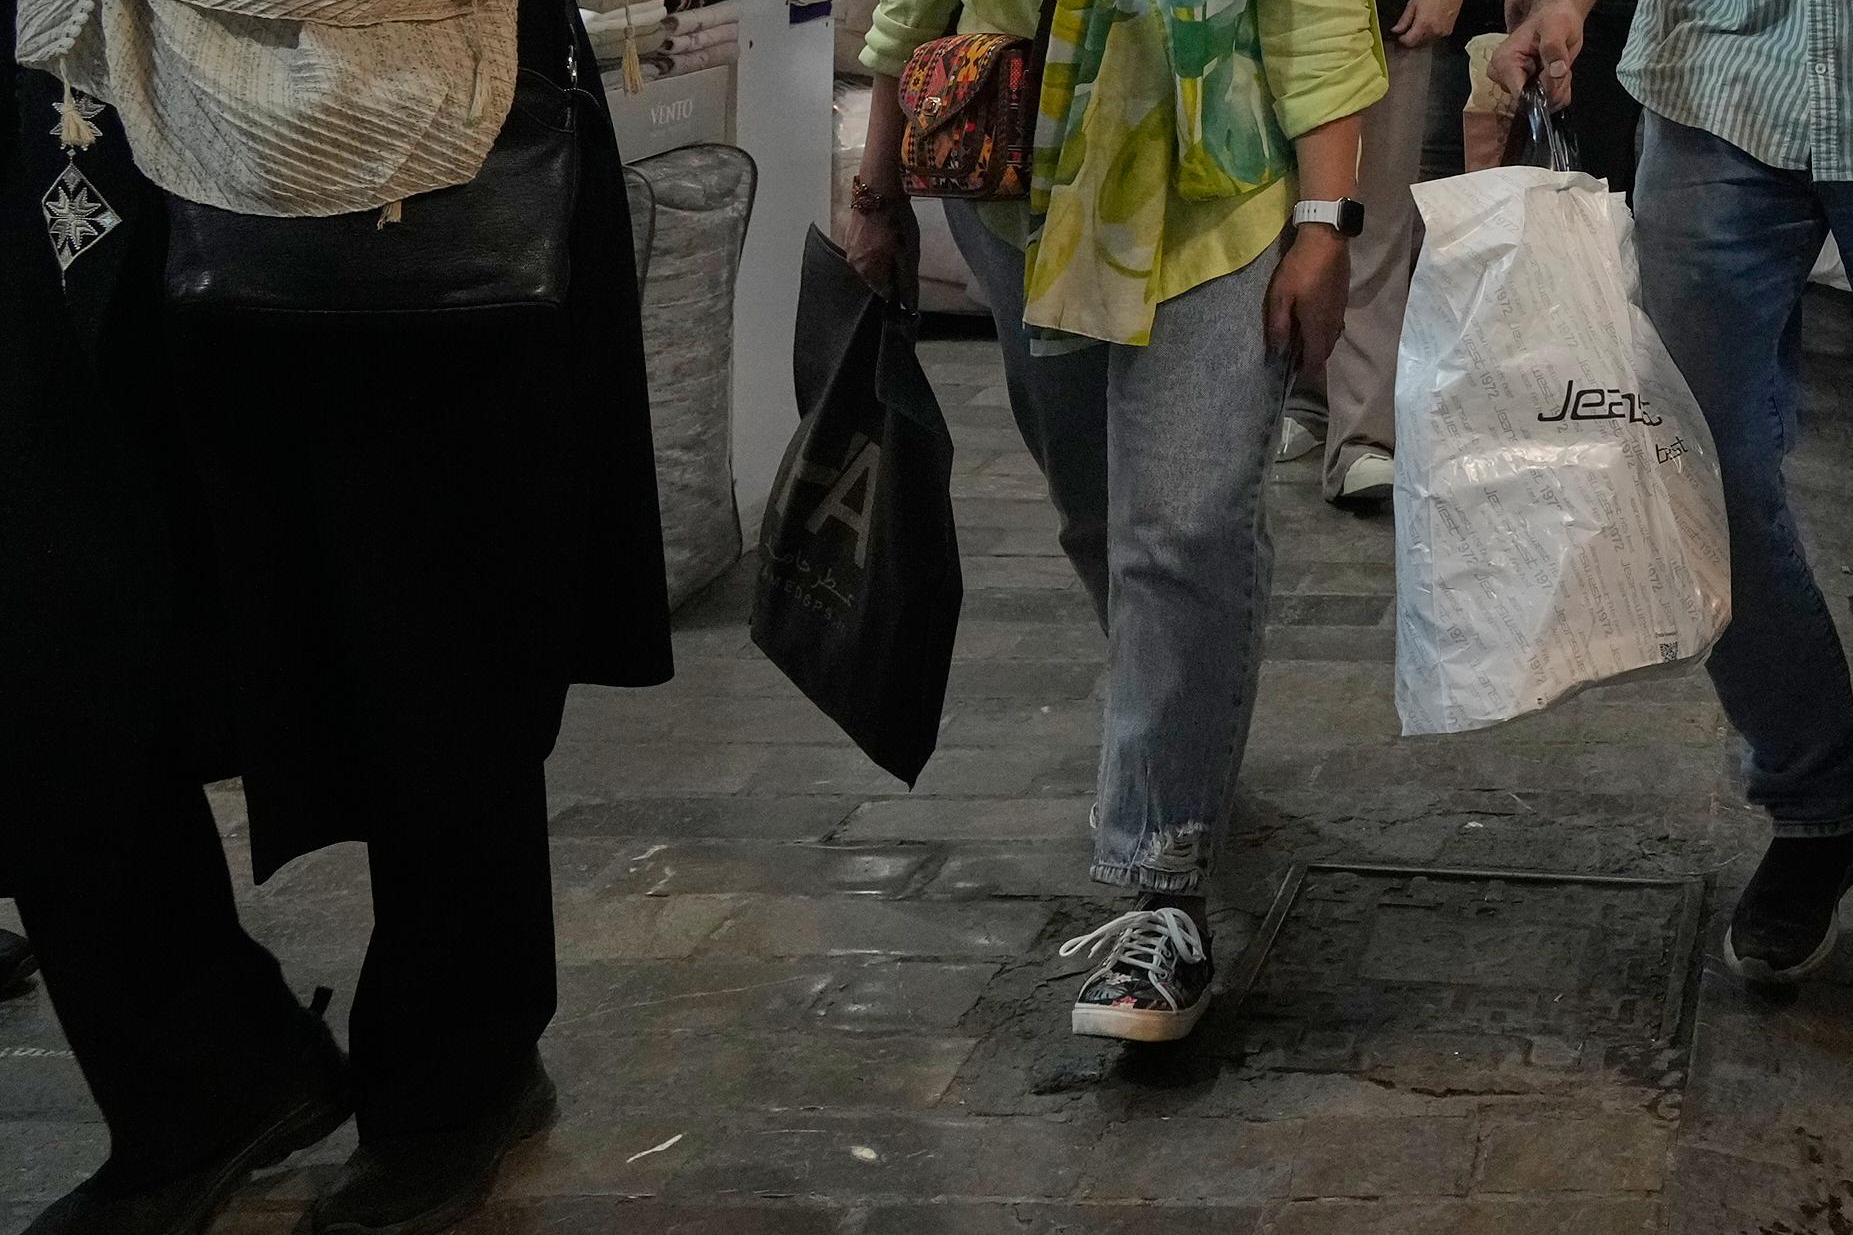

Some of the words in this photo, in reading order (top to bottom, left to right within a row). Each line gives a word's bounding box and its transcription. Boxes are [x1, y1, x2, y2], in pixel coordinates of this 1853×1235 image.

[1477, 371, 1502, 401] 1972
[1592, 606, 1617, 638] 1972
[1490, 283, 1517, 318] 1972
[1603, 522, 1628, 553] 1972
[1525, 654, 1550, 687] 1972
